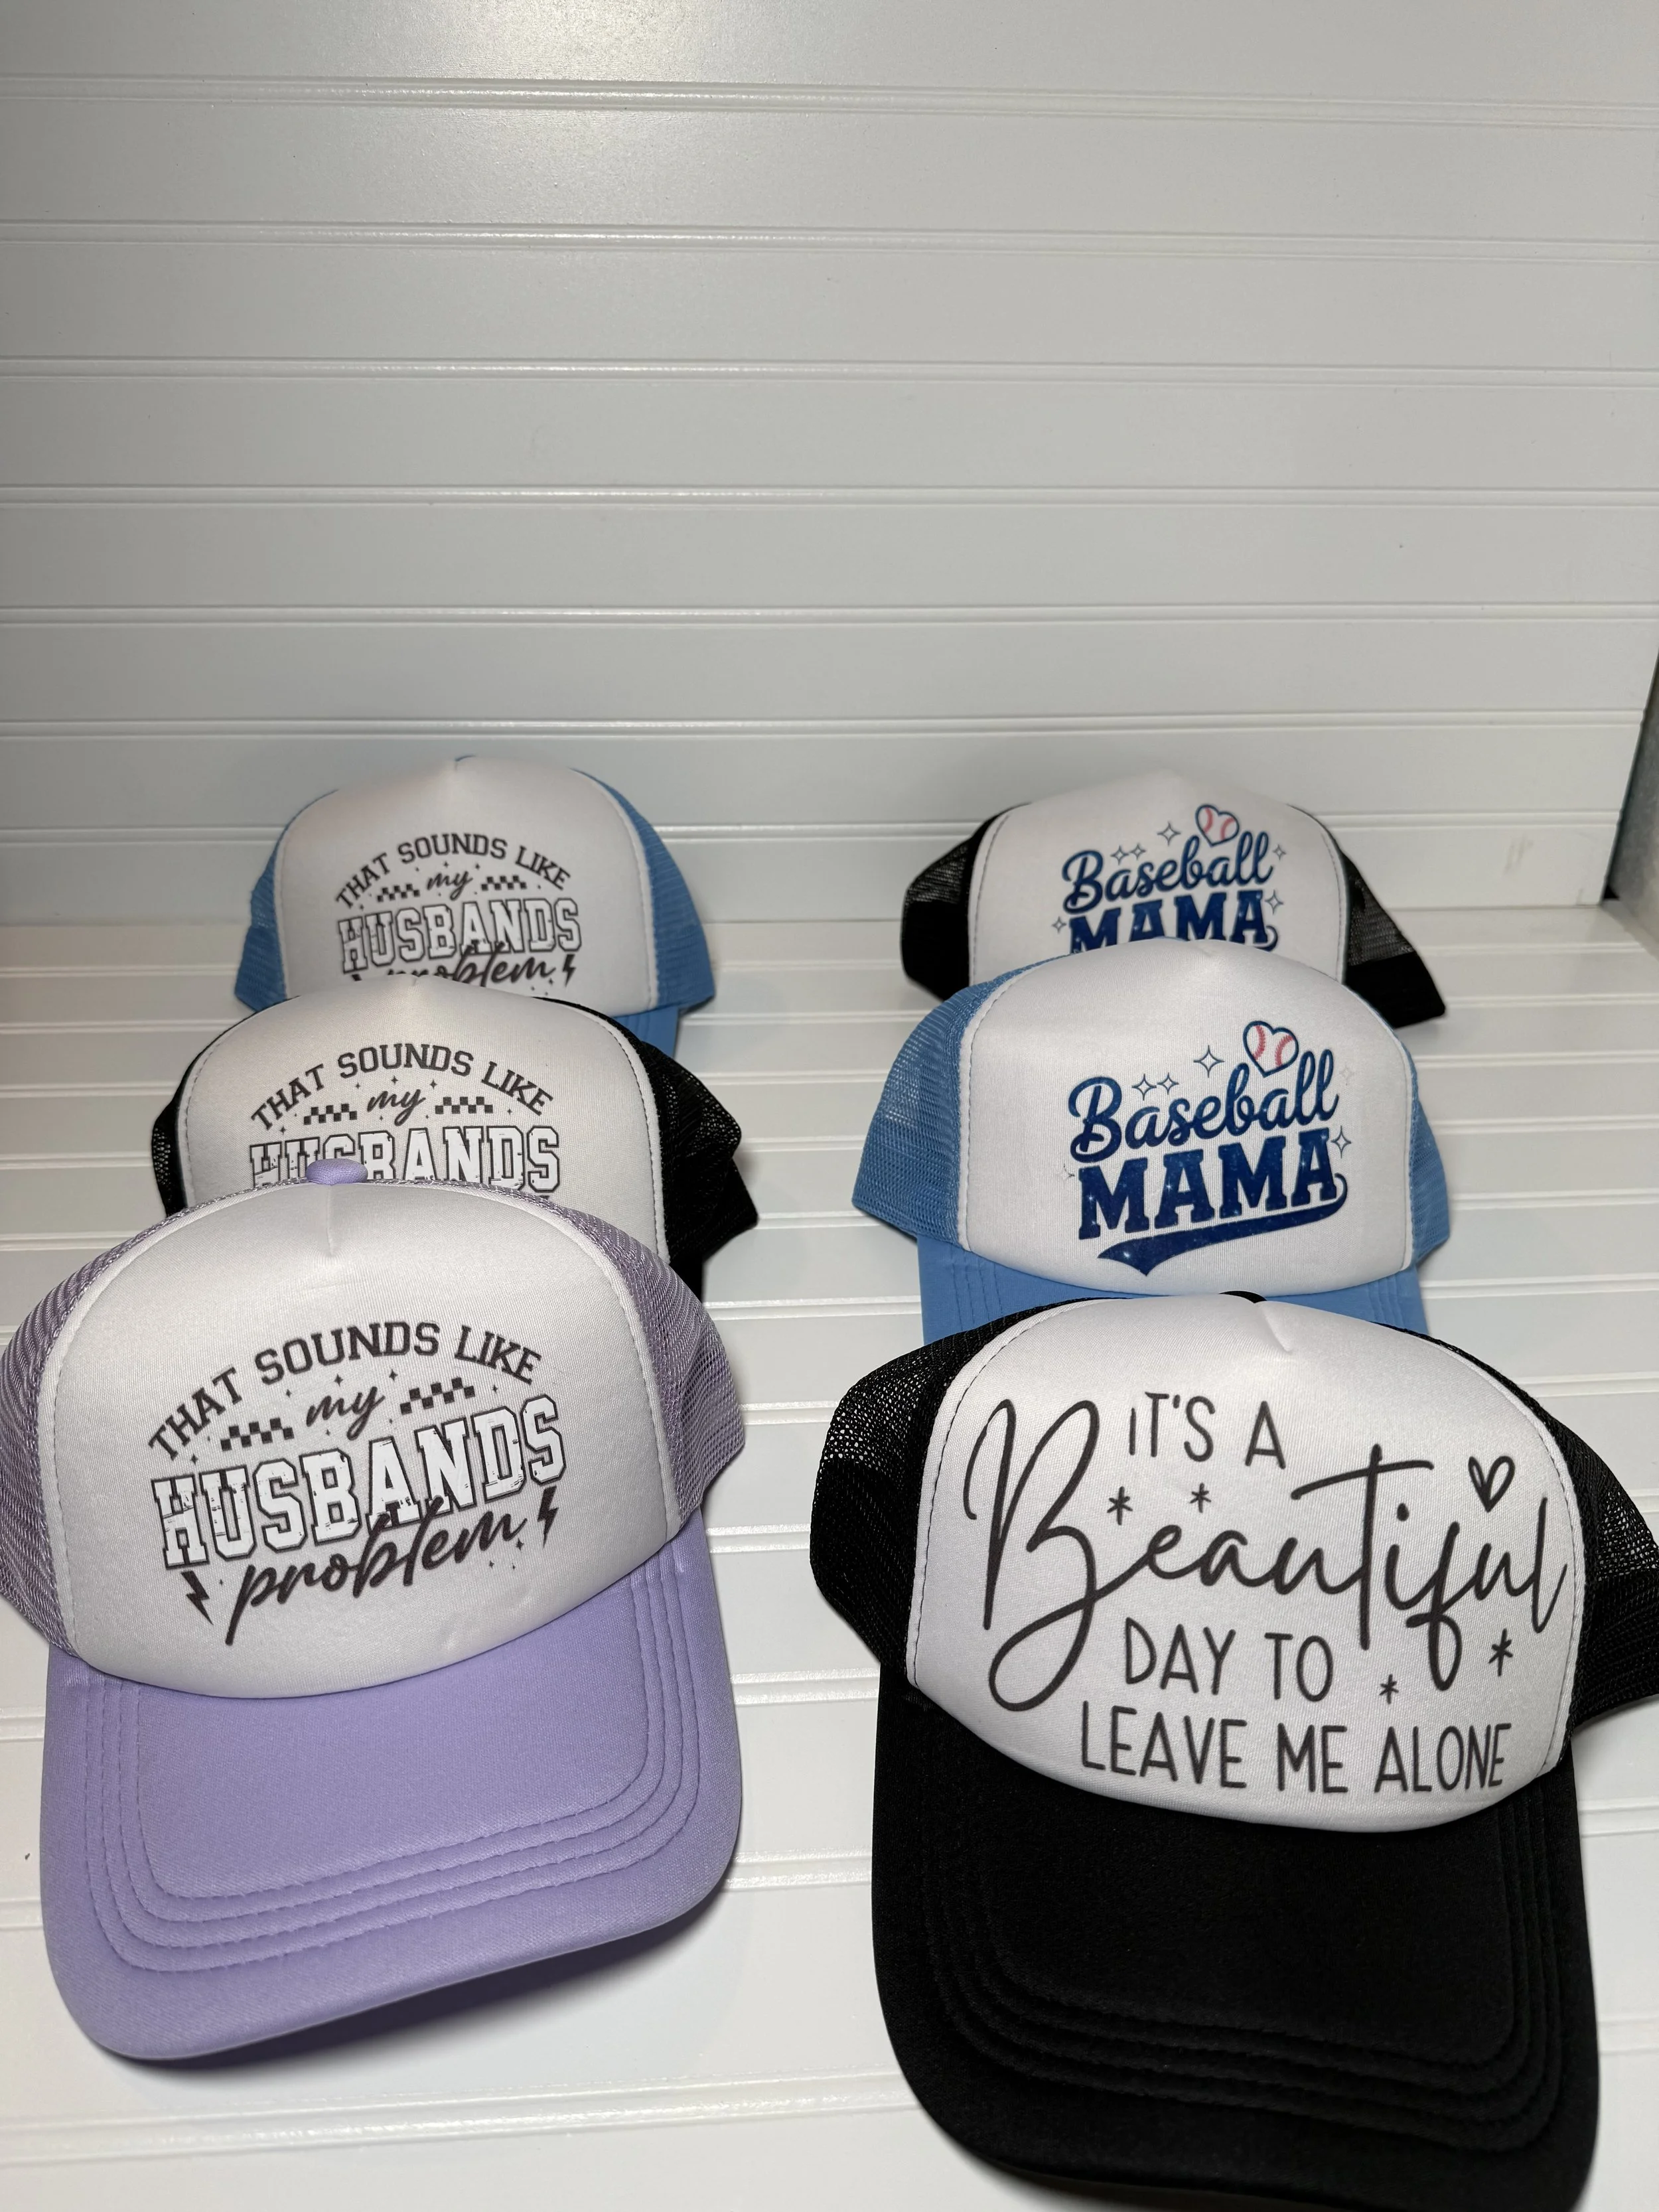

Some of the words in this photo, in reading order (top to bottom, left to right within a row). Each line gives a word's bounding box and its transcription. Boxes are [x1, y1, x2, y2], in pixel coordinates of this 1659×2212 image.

[336, 853, 389, 909] THAT
[397, 833, 508, 864] SOUNDS
[514, 846, 571, 891] LIKE
[426, 869, 472, 901] my
[1062, 831, 1274, 915] Baseball
[338, 897, 582, 974] HUSBANDS
[1069, 890, 1268, 954] MAMA
[251, 1064, 325, 1130] THAT
[337, 1043, 474, 1078] SOUNDS
[481, 1061, 553, 1116] LIKE
[366, 1087, 426, 1127] my
[1068, 1049, 1339, 1163] Baseball
[1078, 1127, 1337, 1240] MAMA
[148, 1367, 242, 1460] THAT
[254, 1322, 440, 1385] SOUNDS
[454, 1325, 541, 1384] LIKE
[305, 1386, 385, 1441] my
[1129, 1392, 1216, 1460] IT'S
[1245, 1400, 1286, 1469] A
[151, 1394, 567, 1570] HUSBANDS
[224, 1495, 528, 1646] problem
[962, 1398, 1568, 1711] Beautiful
[1124, 1617, 1236, 1695] DAY
[1263, 1631, 1334, 1702] TO
[1082, 1700, 1248, 1789] LEAVE
[1276, 1722, 1349, 1794] ME
[1374, 1722, 1513, 1794] ALONE
